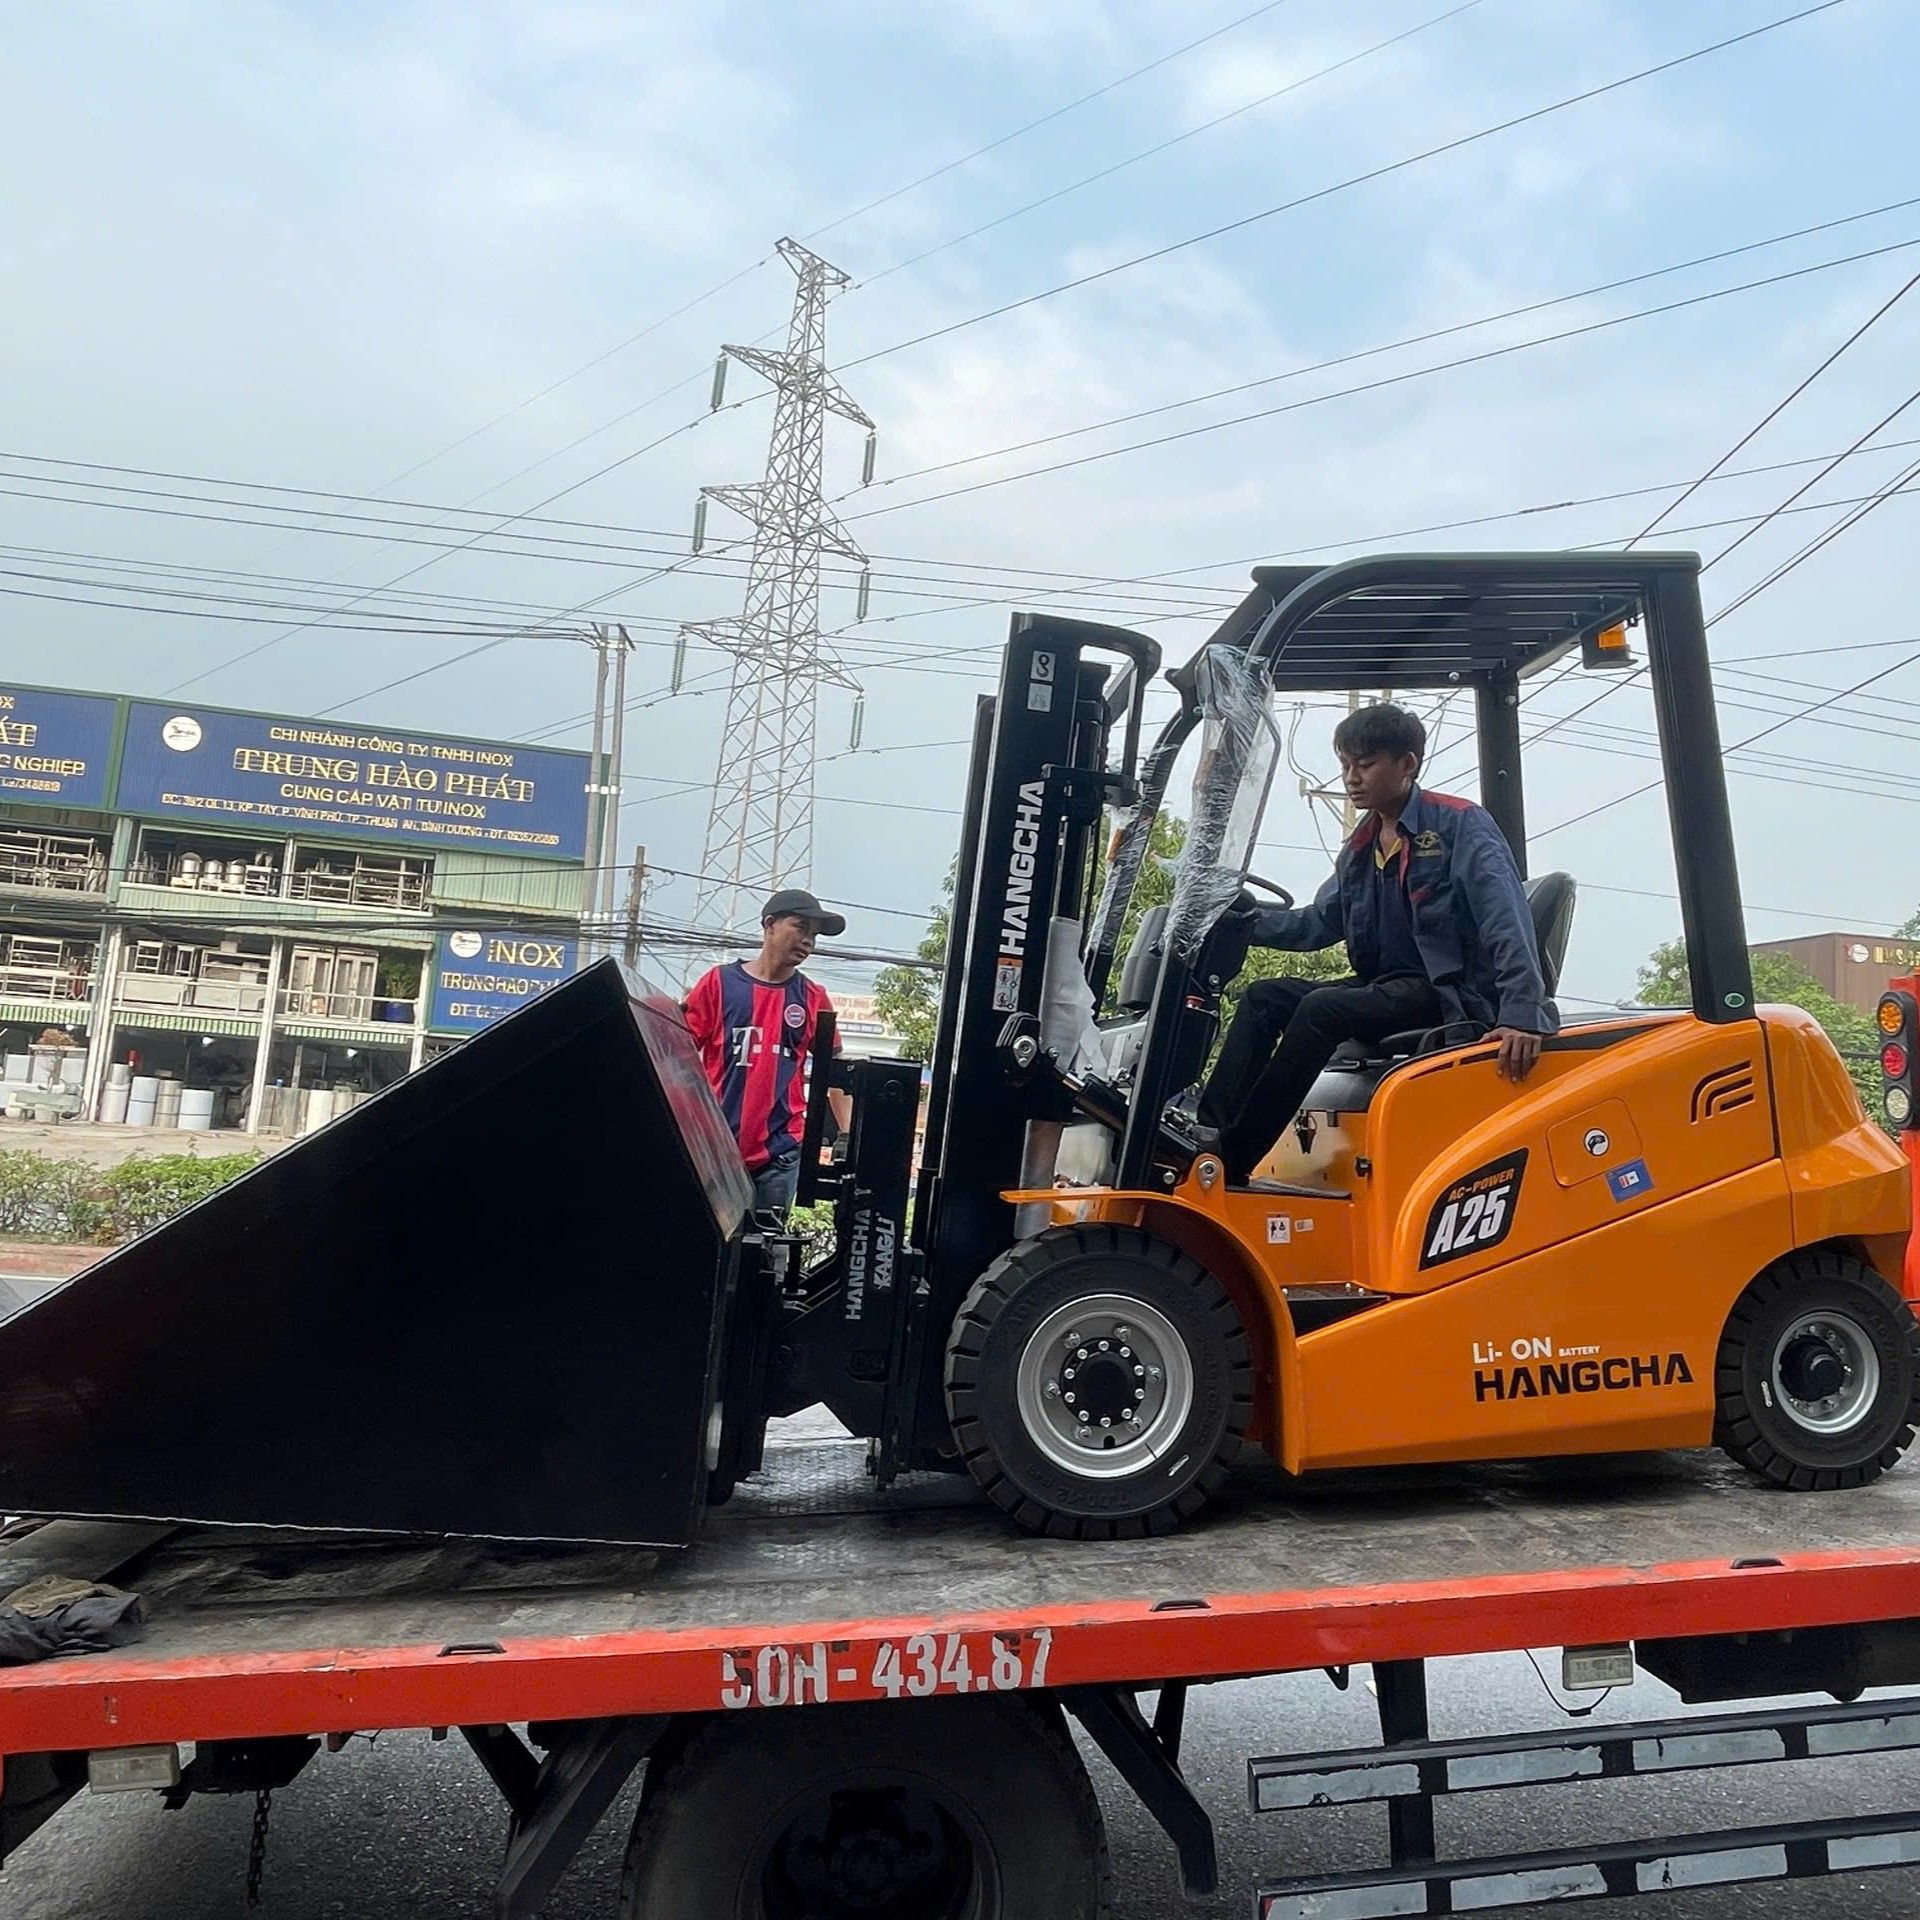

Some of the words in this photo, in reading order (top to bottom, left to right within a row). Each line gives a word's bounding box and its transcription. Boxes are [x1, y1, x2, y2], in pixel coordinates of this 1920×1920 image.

[270, 727, 298, 741] CHI
[300, 730, 355, 748] NHÁNH
[357, 736, 404, 754] CÔNG
[407, 743, 428, 757] TY
[431, 746, 474, 762] TNHH
[476, 751, 513, 767] INOX
[233, 748, 359, 782] TRUNG
[366, 760, 438, 791] HÀO
[444, 772, 534, 802] PHÁT
[280, 783, 334, 803] CUNG
[443, 803, 486, 819] INOX
[999, 780, 1045, 956] HANGCHA
[488, 939, 565, 968] INOX
[1448, 1168, 1515, 1202] AC-POWER
[1427, 1185, 1511, 1259] A25
[845, 1209, 871, 1320] HANGCHA
[1510, 1336, 1552, 1360] ON
[1558, 1345, 1600, 1357] BATTERY
[1473, 1352, 1695, 1402] HANGCHA
